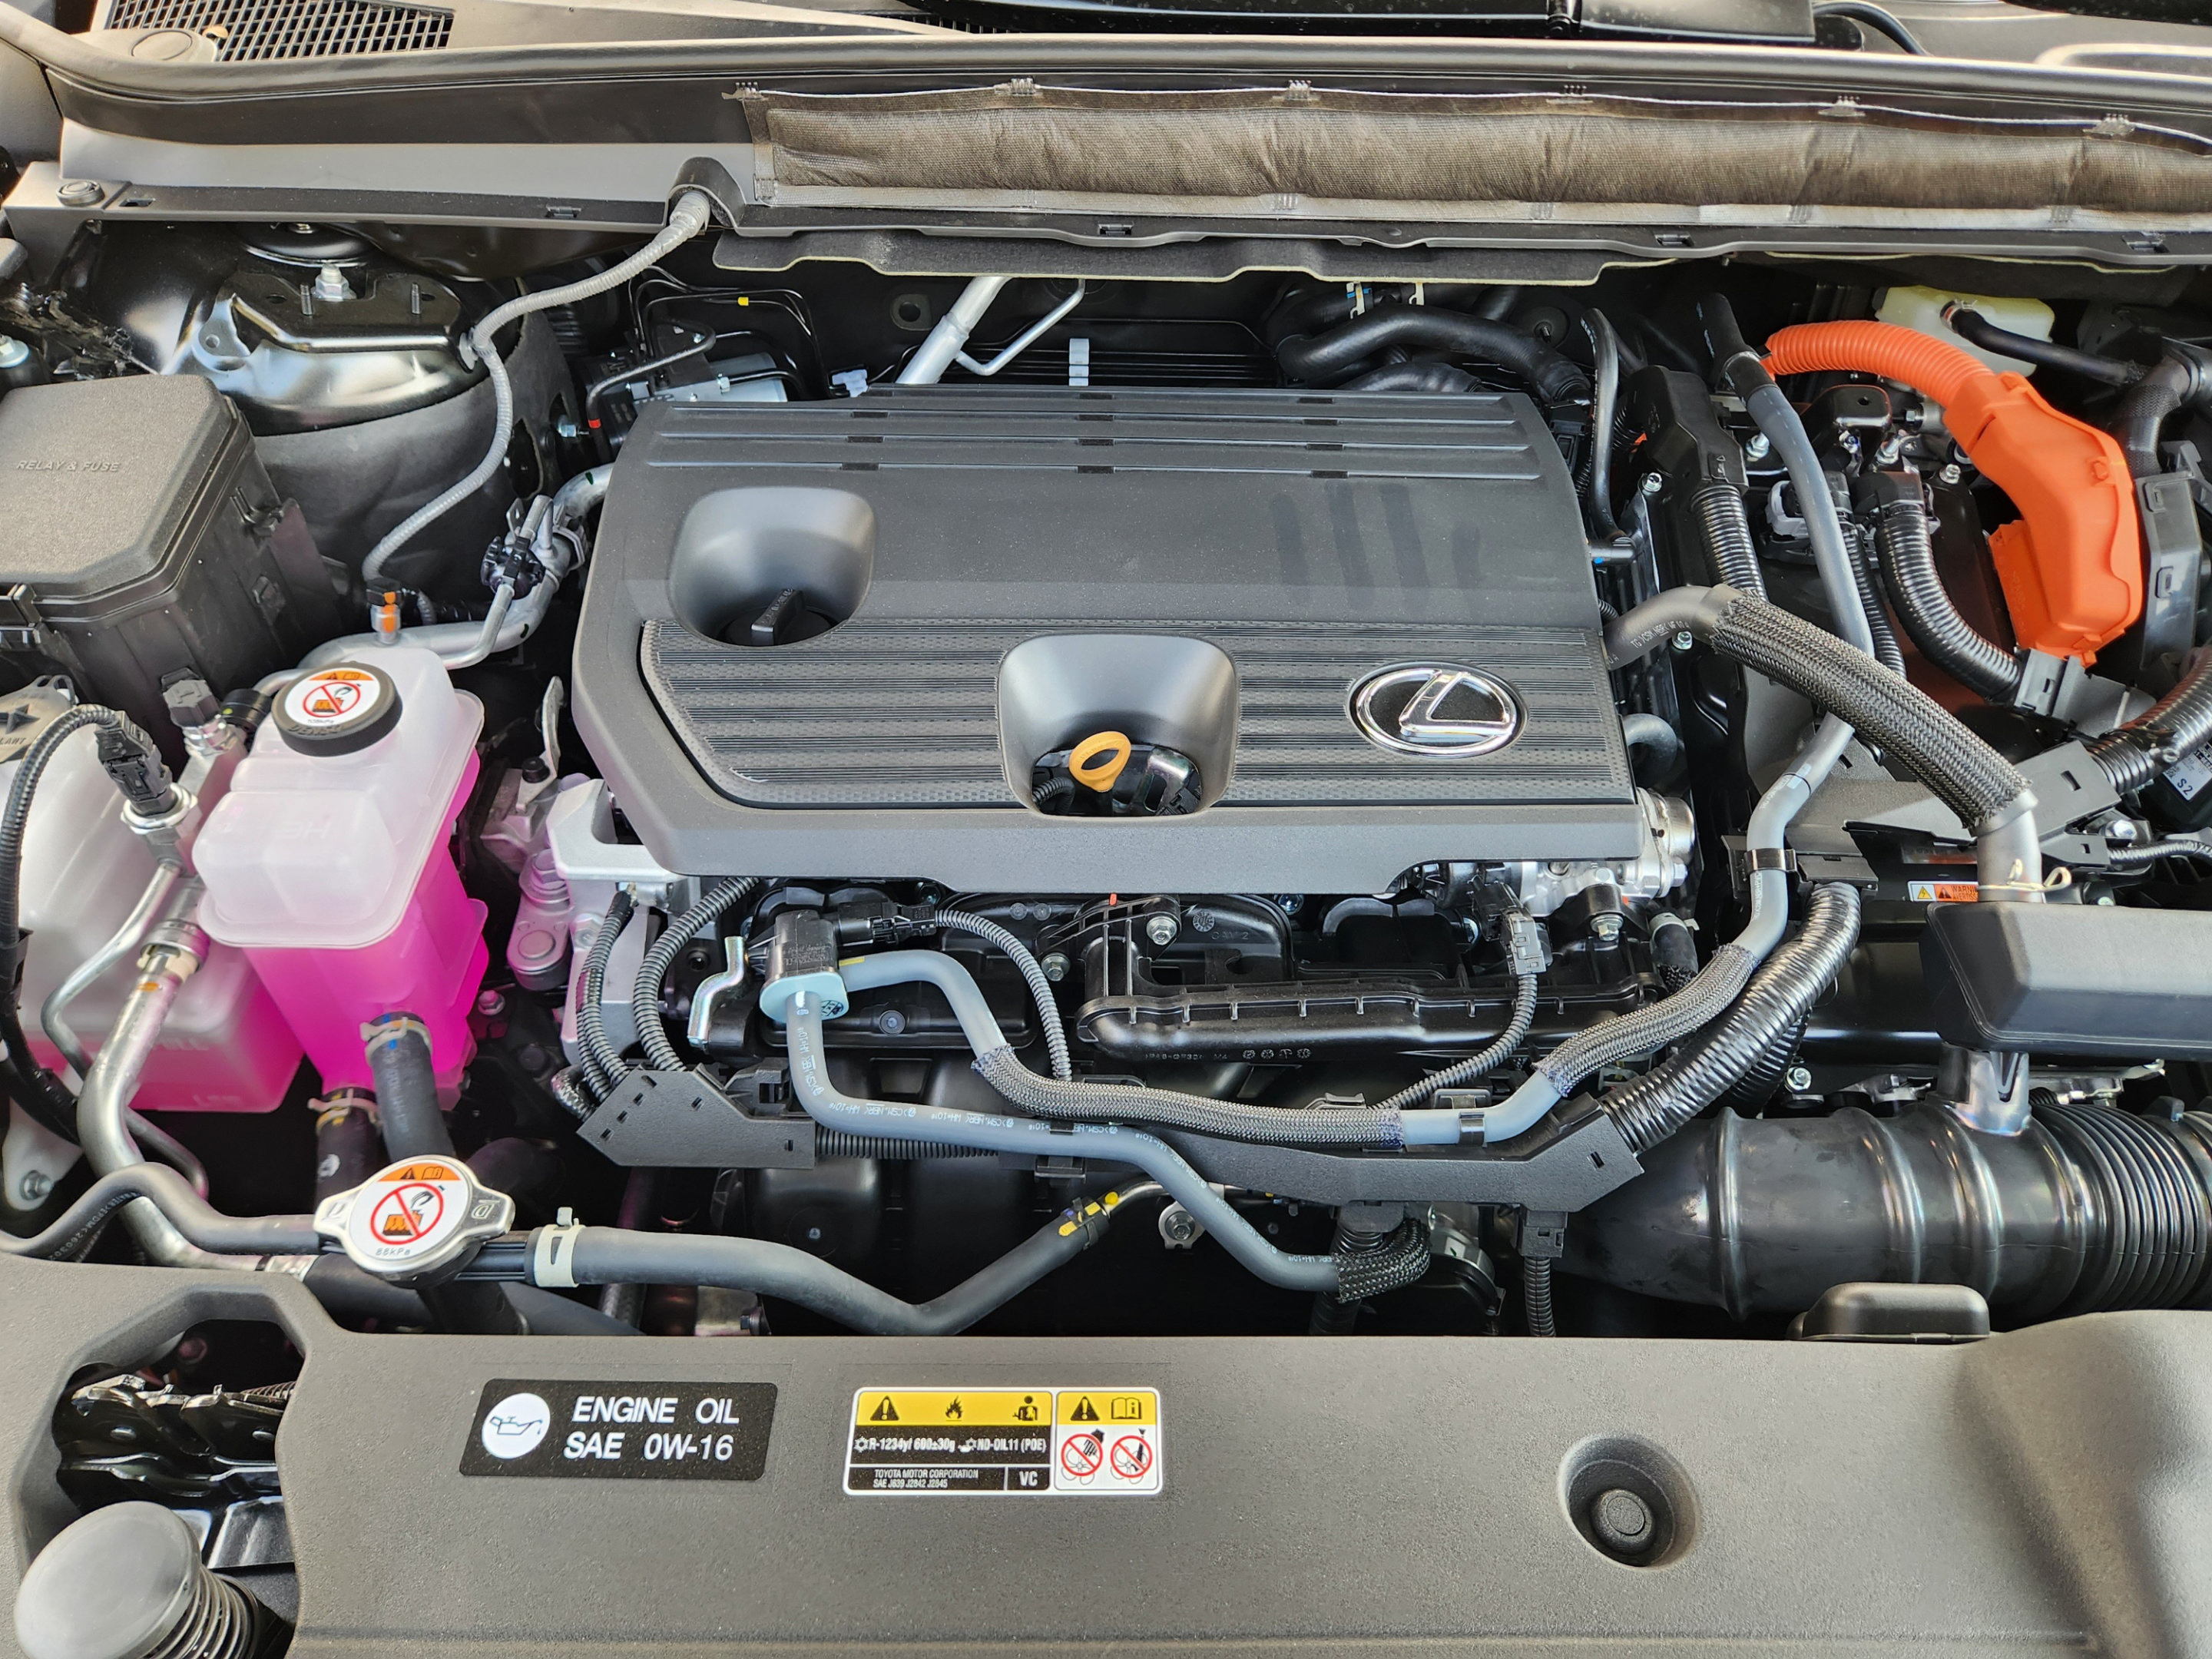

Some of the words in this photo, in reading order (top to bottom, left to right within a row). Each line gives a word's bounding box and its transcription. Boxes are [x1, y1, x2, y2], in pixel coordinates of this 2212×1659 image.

[16, 460, 65, 472] RELAY
[66, 461, 78, 472] &
[81, 462, 121, 472] FUSE
[1951, 885, 1977, 893] WARNI
[571, 1396, 678, 1423] ENGINE
[695, 1398, 740, 1424] OIL
[563, 1432, 625, 1459] SAE
[644, 1433, 733, 1461] 0W-16
[869, 1438, 912, 1452] R-1234yf
[913, 1438, 955, 1452] 600±30g
[1021, 1438, 1047, 1452] (POE)
[874, 1469, 902, 1479] TOYOTA
[902, 1469, 929, 1479] MOTOR
[929, 1469, 979, 1479] CORPORATION
[1018, 1471, 1038, 1486] VC
[873, 1479, 886, 1488] SAE
[887, 1479, 905, 1488] J639
[926, 1479, 949, 1488] J2845
